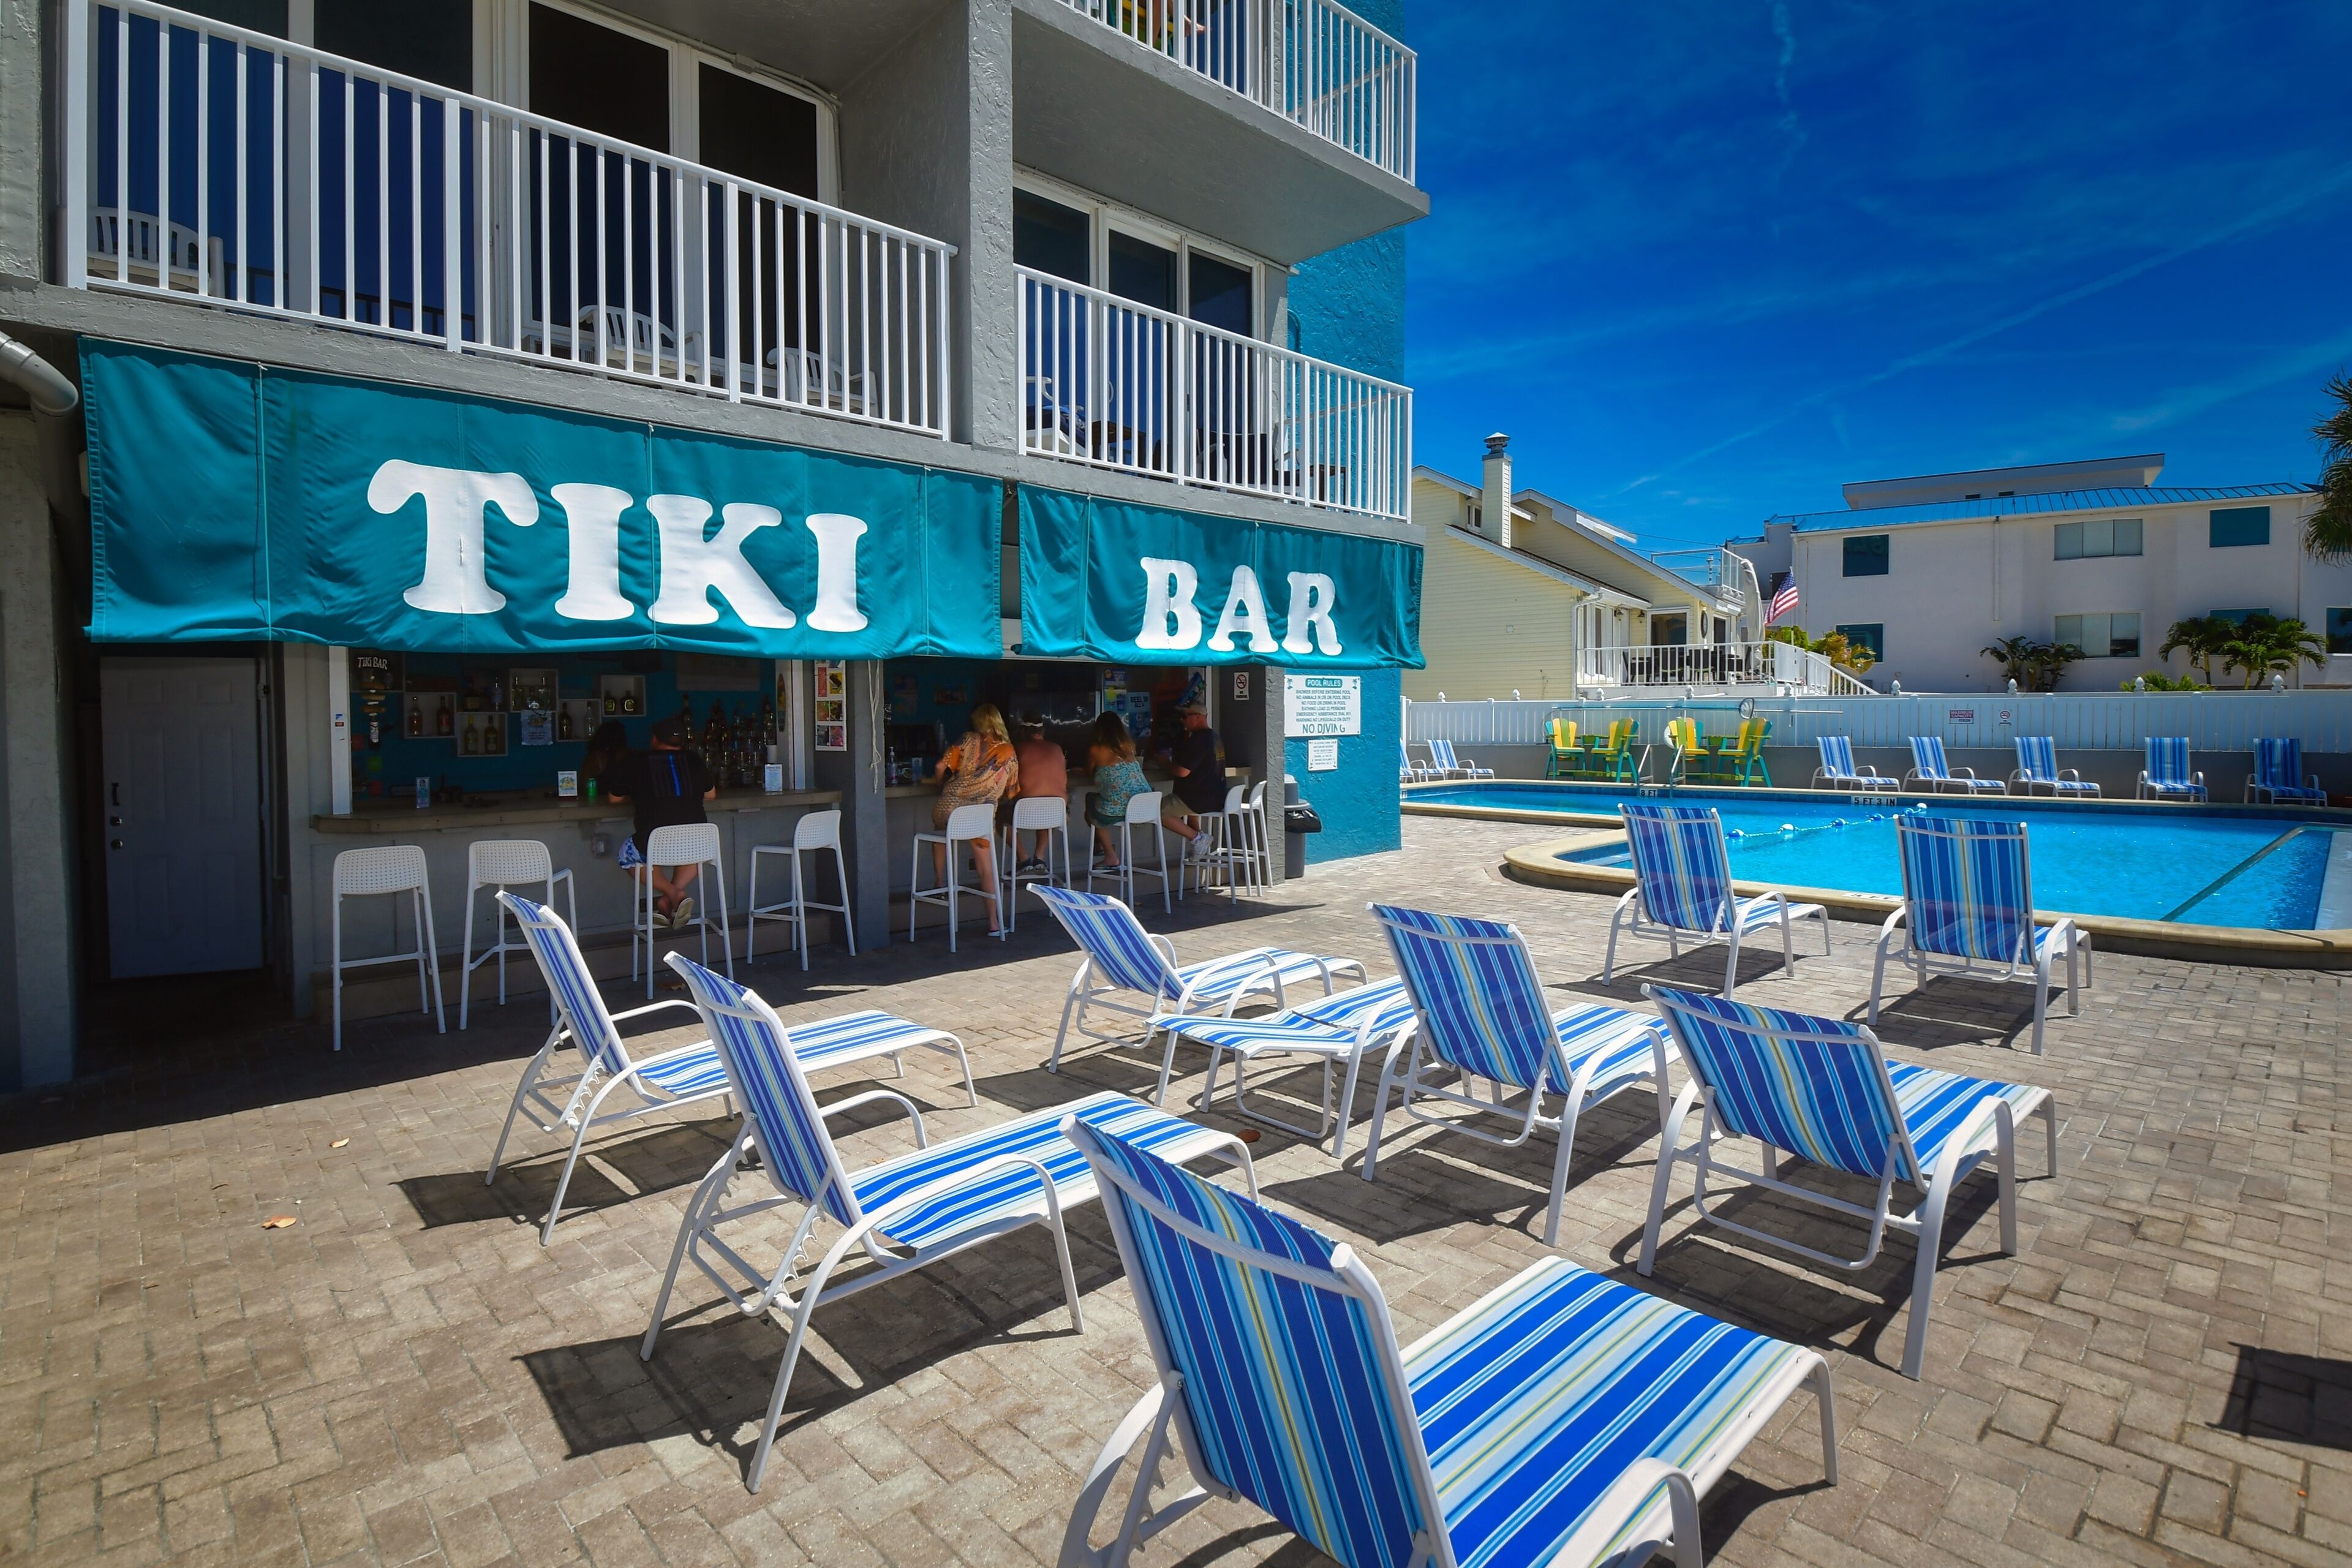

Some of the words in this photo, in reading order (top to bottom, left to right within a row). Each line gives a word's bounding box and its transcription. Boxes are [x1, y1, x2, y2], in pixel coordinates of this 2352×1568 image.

[368, 459, 868, 632] TIKI
[1135, 556, 1343, 656] BAR
[373, 657, 388, 670] BAR
[1302, 723, 1315, 733] NO
[1317, 723, 1346, 734] DIVING
